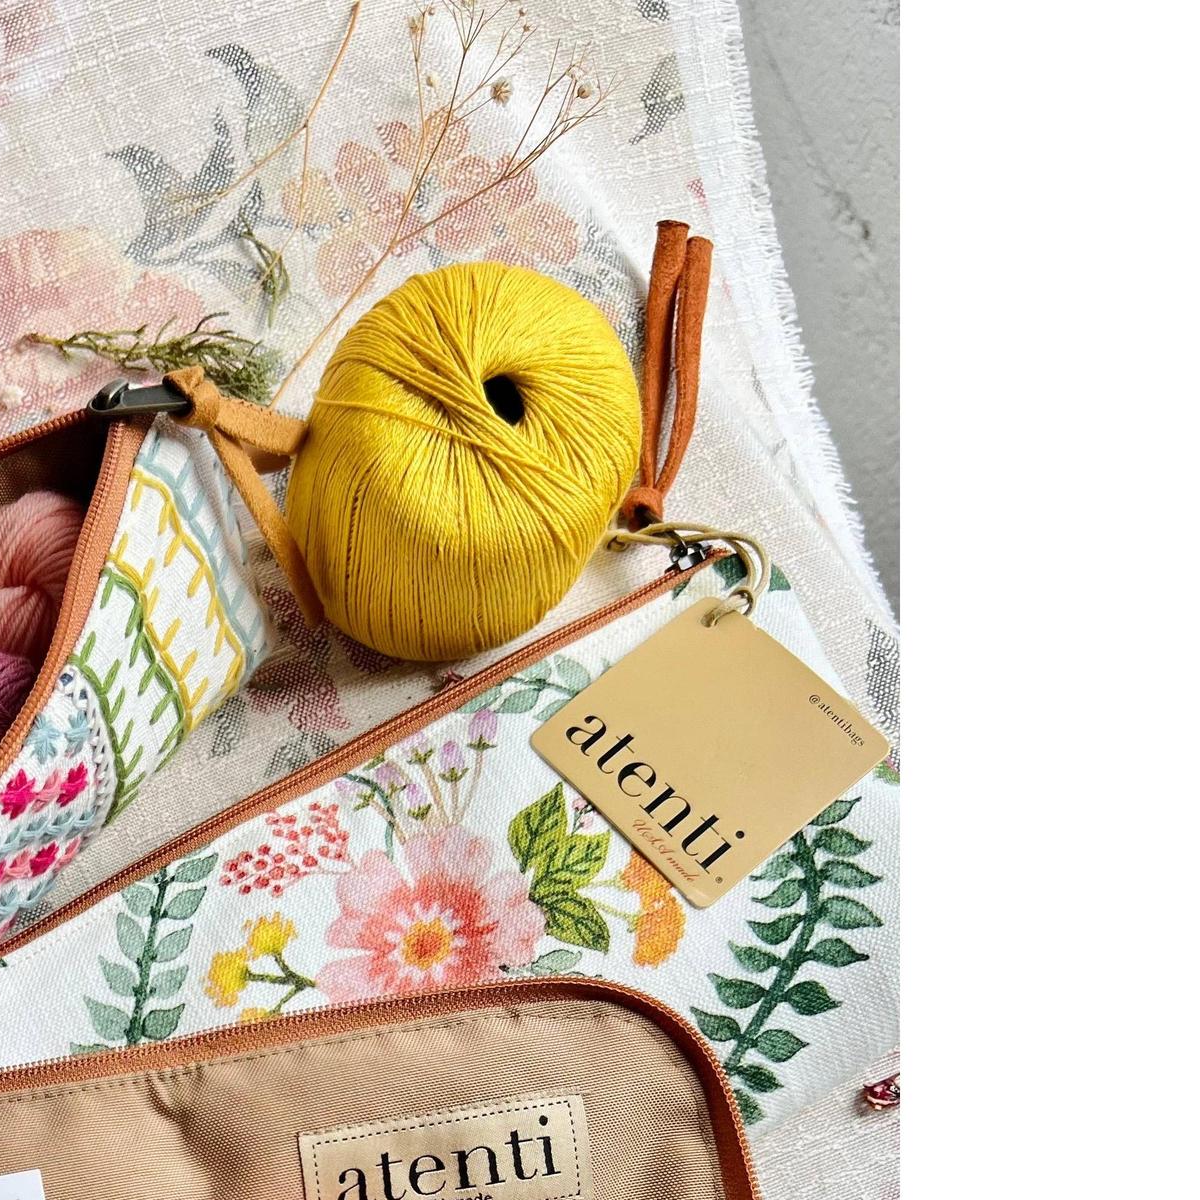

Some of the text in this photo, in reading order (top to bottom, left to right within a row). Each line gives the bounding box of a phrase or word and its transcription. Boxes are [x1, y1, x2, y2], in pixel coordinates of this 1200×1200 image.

[808, 694, 865, 748] @atentibags
[565, 715, 745, 875] atenti
[666, 857, 700, 883] made
